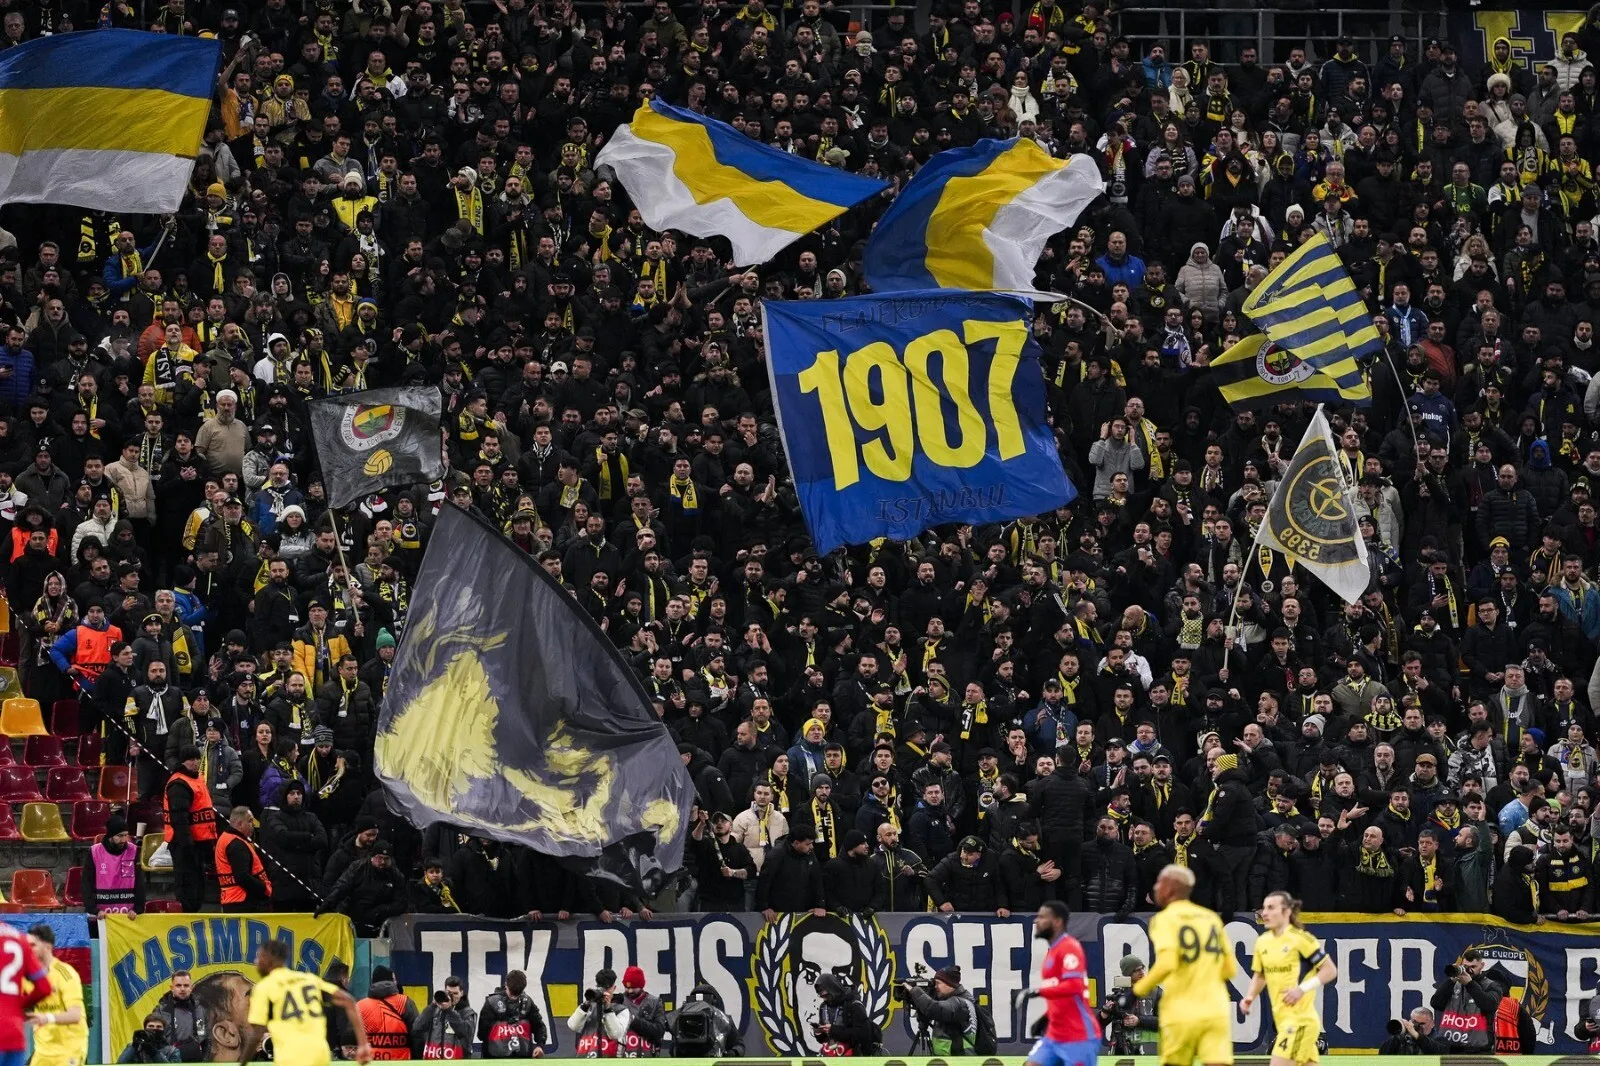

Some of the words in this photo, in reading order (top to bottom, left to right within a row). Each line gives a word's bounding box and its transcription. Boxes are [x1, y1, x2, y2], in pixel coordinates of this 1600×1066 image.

[798, 319, 1028, 491] 1907
[1179, 925, 1223, 964] 94
[1492, 950, 1525, 960] EUROPE
[1, 940, 24, 995] 2
[1316, 938, 1438, 1034] FB
[280, 985, 325, 1021] 45
[1279, 1037, 1288, 1051] 4
